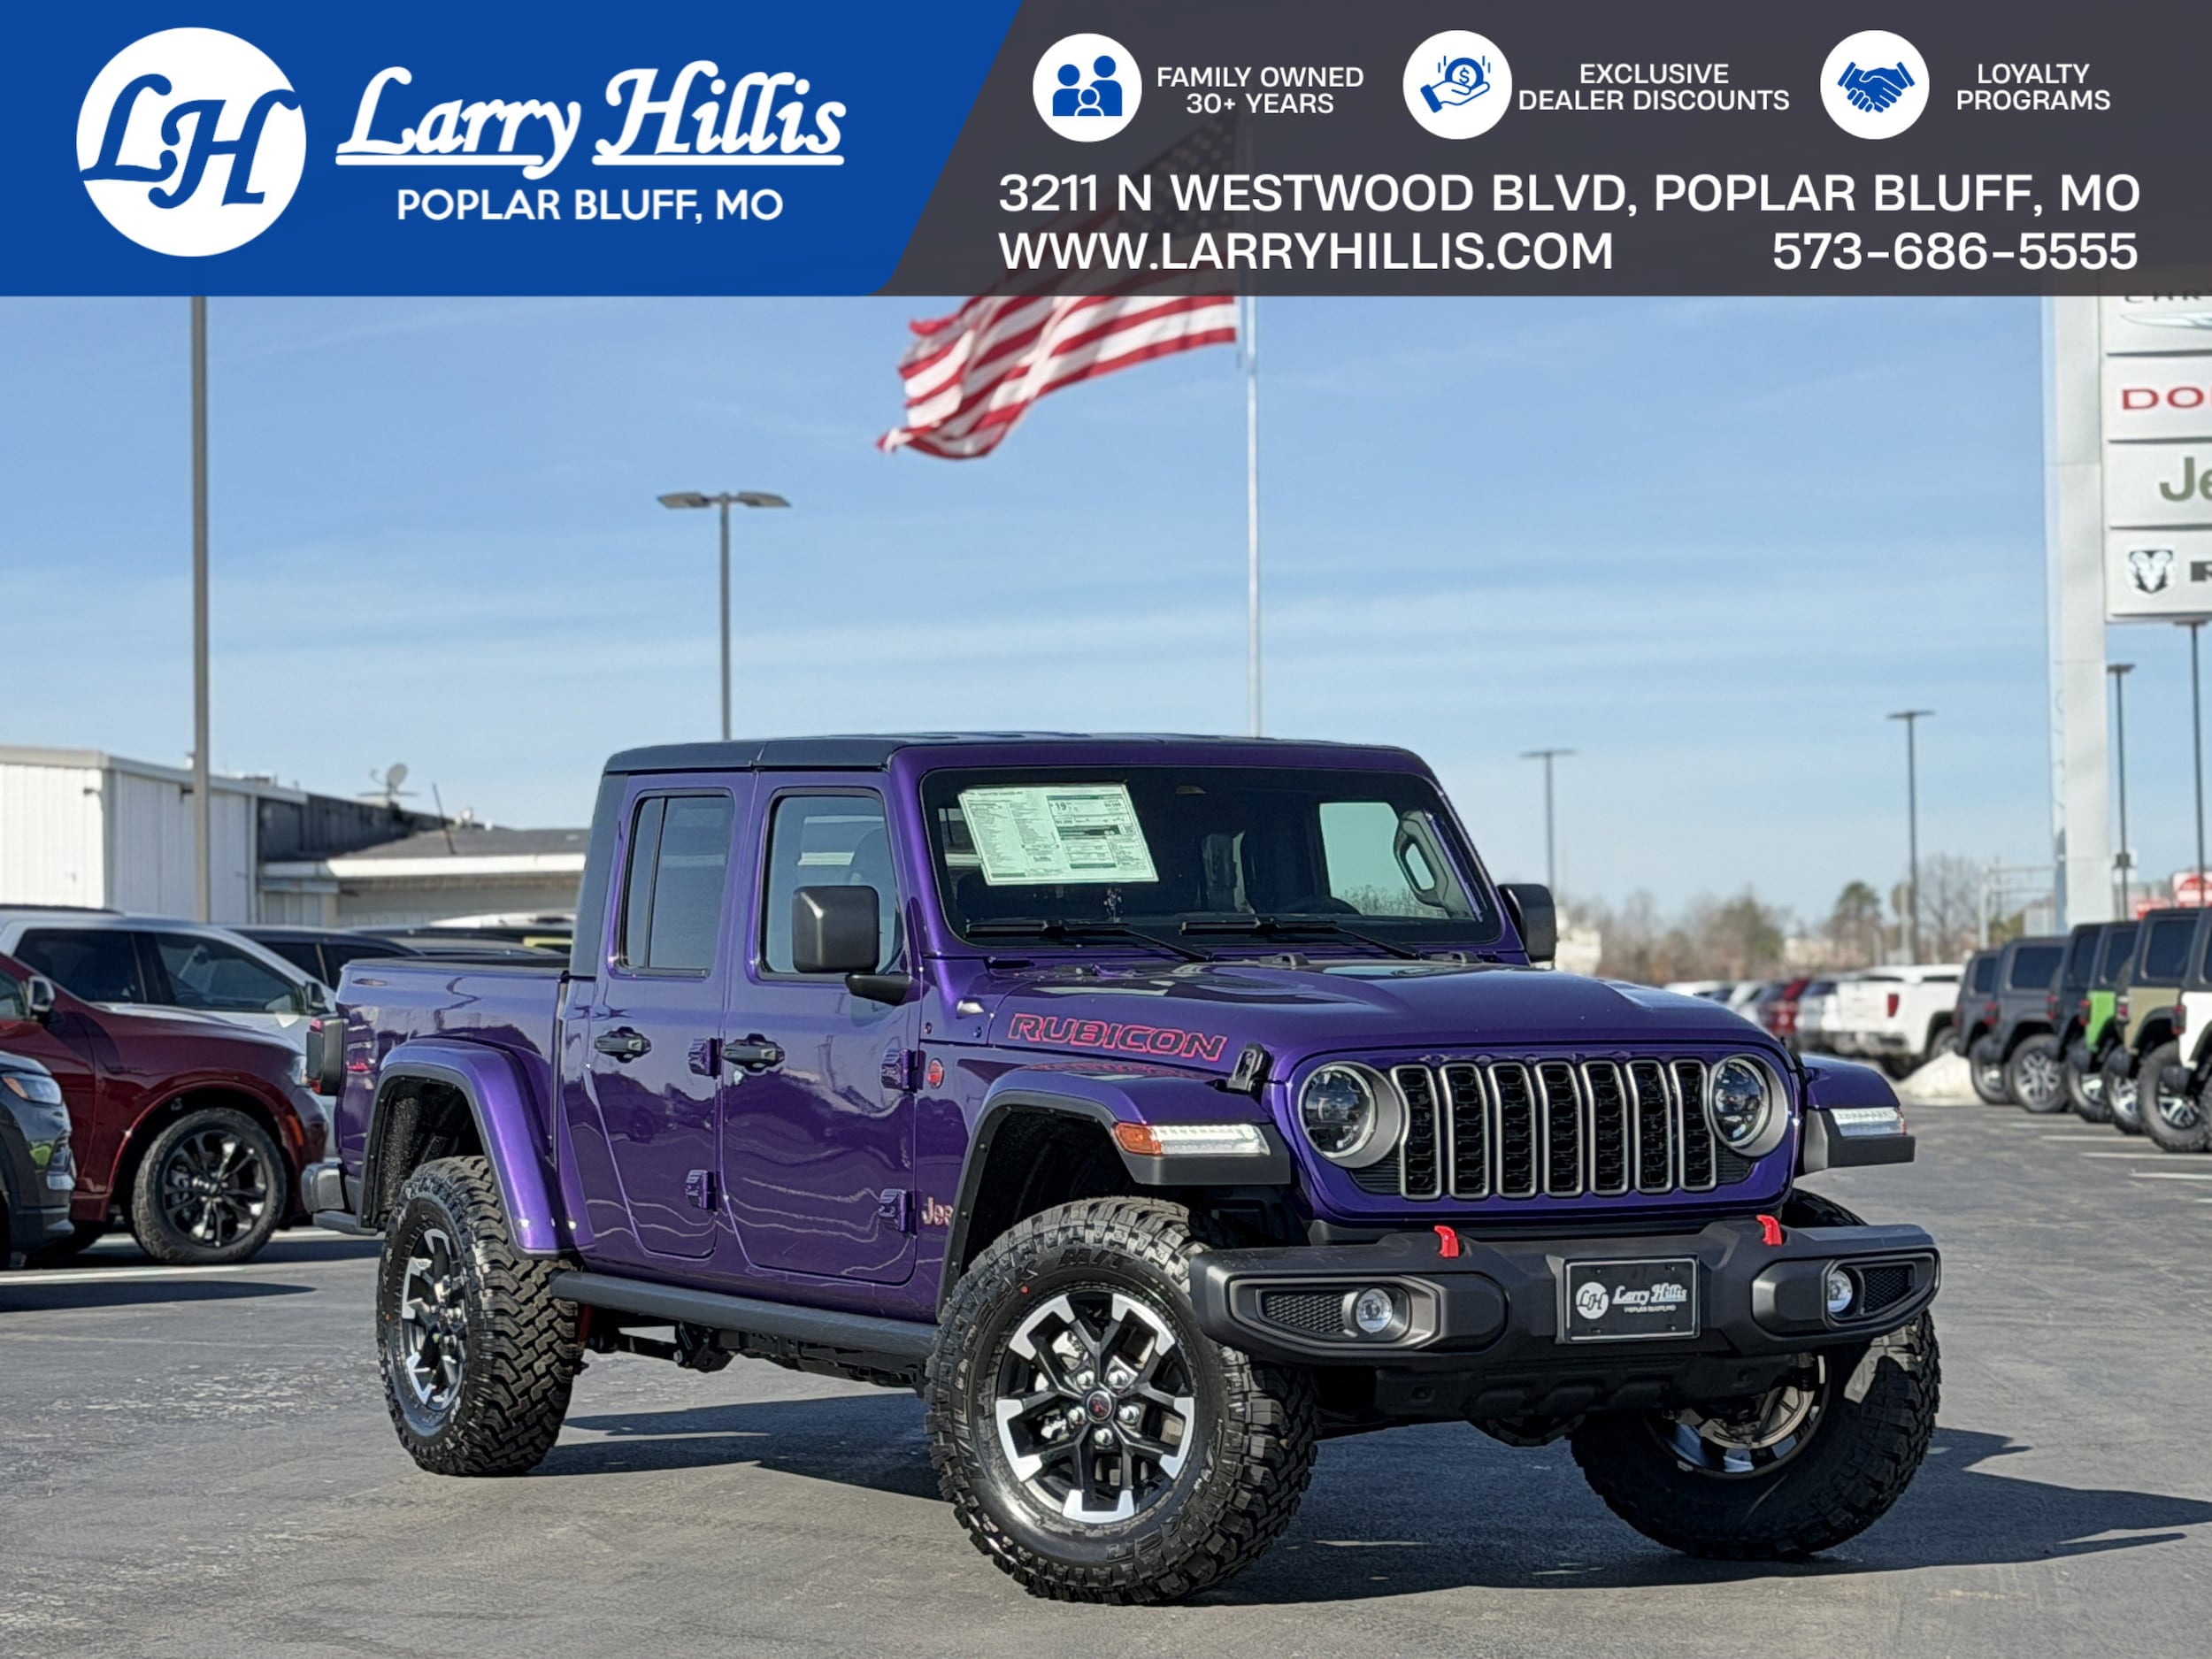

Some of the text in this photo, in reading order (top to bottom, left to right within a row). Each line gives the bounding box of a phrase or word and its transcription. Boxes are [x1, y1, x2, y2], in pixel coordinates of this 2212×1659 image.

[2120, 387, 2212, 411] DO
[1008, 1013, 1227, 1062] RUBICON
[1613, 1283, 1687, 1305] Larry Hillis
